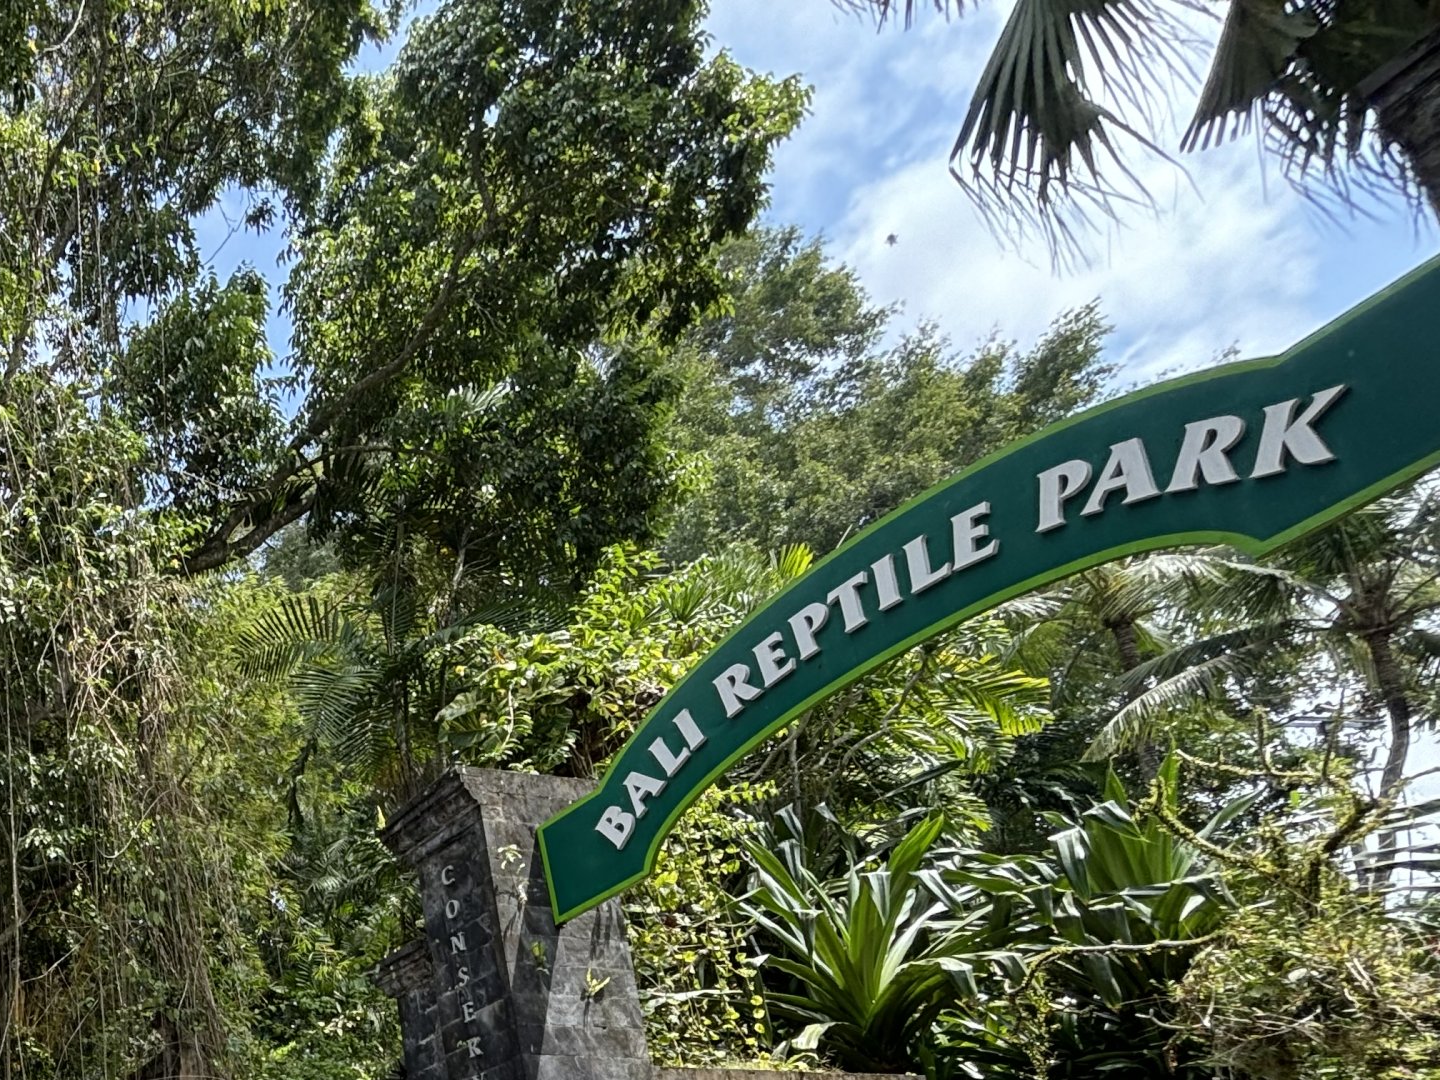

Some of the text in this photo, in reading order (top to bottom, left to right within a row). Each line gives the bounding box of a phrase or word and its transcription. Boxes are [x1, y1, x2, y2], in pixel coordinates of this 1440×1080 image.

[594, 384, 1349, 851] BALI REPTILE PARK
